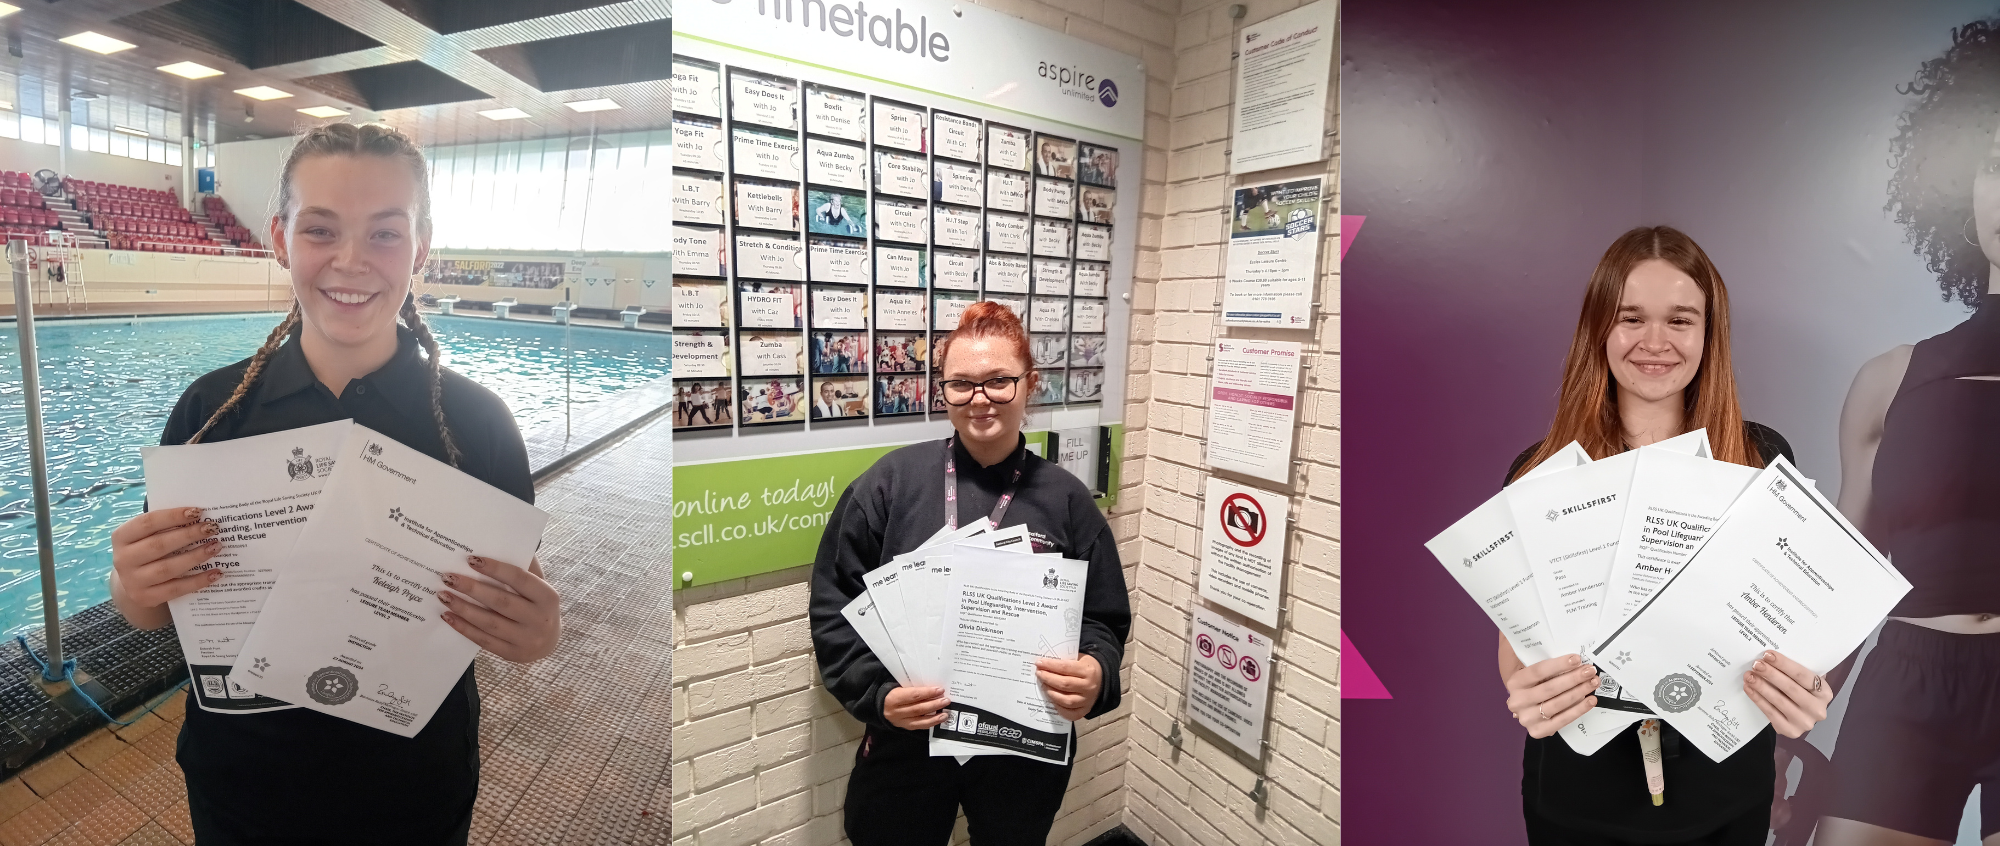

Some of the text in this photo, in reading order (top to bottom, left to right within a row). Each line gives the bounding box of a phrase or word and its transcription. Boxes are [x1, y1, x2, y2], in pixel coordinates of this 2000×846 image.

[758, 0, 950, 62] metable
[1245, 43, 1270, 56] Customer
[1270, 38, 1285, 48] Code
[1286, 34, 1293, 42] of
[1293, 26, 1318, 40] Conduct
[1038, 61, 1095, 90] aspire
[745, 87, 760, 97] Easy
[762, 92, 778, 100] Does
[1062, 88, 1095, 102] unlimited
[824, 103, 842, 112] Boxfit
[830, 116, 851, 124] Denise
[890, 114, 907, 122] Sprint
[674, 127, 692, 137] Yoga
[949, 128, 964, 136] Circuit
[734, 136, 799, 152] Prime Time Exercise
[817, 149, 854, 161] Aqua Zumba
[835, 162, 852, 172] Becky
[902, 164, 923, 174] Stability
[952, 173, 973, 182] Spinning
[672, 197, 710, 207] With Barry
[747, 192, 783, 202] Kettlebells
[748, 204, 783, 215] With Barry
[1286, 218, 1313, 230] SOCCER
[1287, 224, 1310, 236] STARS
[674, 237, 687, 246] ody
[454, 260, 490, 270] SALFORD
[1066, 438, 1084, 448] FILL
[1061, 450, 1088, 462] ME UP
[363, 454, 417, 485] HM Government
[673, 476, 835, 518] online today!
[1562, 494, 1616, 516] SKILLSFIRST
[1769, 487, 1807, 522] HM Government
[204, 511, 262, 524] Qualifications
[264, 507, 286, 517] Level
[296, 503, 316, 512] Awa
[254, 516, 308, 530] Intervention
[1646, 515, 1664, 526] RLSS
[1666, 519, 1680, 528] UK
[220, 532, 267, 542] and Rescue
[404, 516, 425, 530] Institute
[434, 531, 473, 553] Apprenticeships
[406, 524, 430, 540] Technical
[430, 536, 455, 552] Education
[1652, 527, 1669, 537] Pool
[1670, 530, 1704, 542] Lifeguar
[1472, 530, 1514, 562] SKILLSFIRST
[1641, 535, 1684, 549] Supervision
[1787, 547, 1802, 561] Institute
[1635, 562, 1662, 573] Amber
[1787, 554, 1803, 570] Technical
[1803, 568, 1820, 586] Education
[372, 564, 386, 574] This
[401, 578, 422, 590] certify
[422, 585, 437, 596] that
[372, 576, 423, 603] Keleigh Pryce
[1560, 582, 1605, 598] Amber Henderson
[359, 591, 378, 602] passed
[390, 604, 425, 622] apprenticeship
[986, 594, 1021, 605] Qualifications
[1750, 583, 1761, 595] This
[1770, 601, 1786, 617] certify
[1784, 613, 1795, 625] that
[360, 599, 377, 609] LEISURE
[390, 611, 410, 622] MEMBER
[961, 604, 991, 613] Supervision
[981, 600, 1012, 611] Lifeguarding,
[1013, 606, 1048, 616] Intervention,
[1741, 592, 1788, 634] Amber Henderson
[976, 626, 1004, 635] Dickinson
[1197, 618, 1221, 633] Customer
[1222, 630, 1239, 642] Notice
[1745, 616, 1755, 628] their
[1753, 624, 1779, 650] apprenticeship
[978, 721, 998, 732] ofqual
